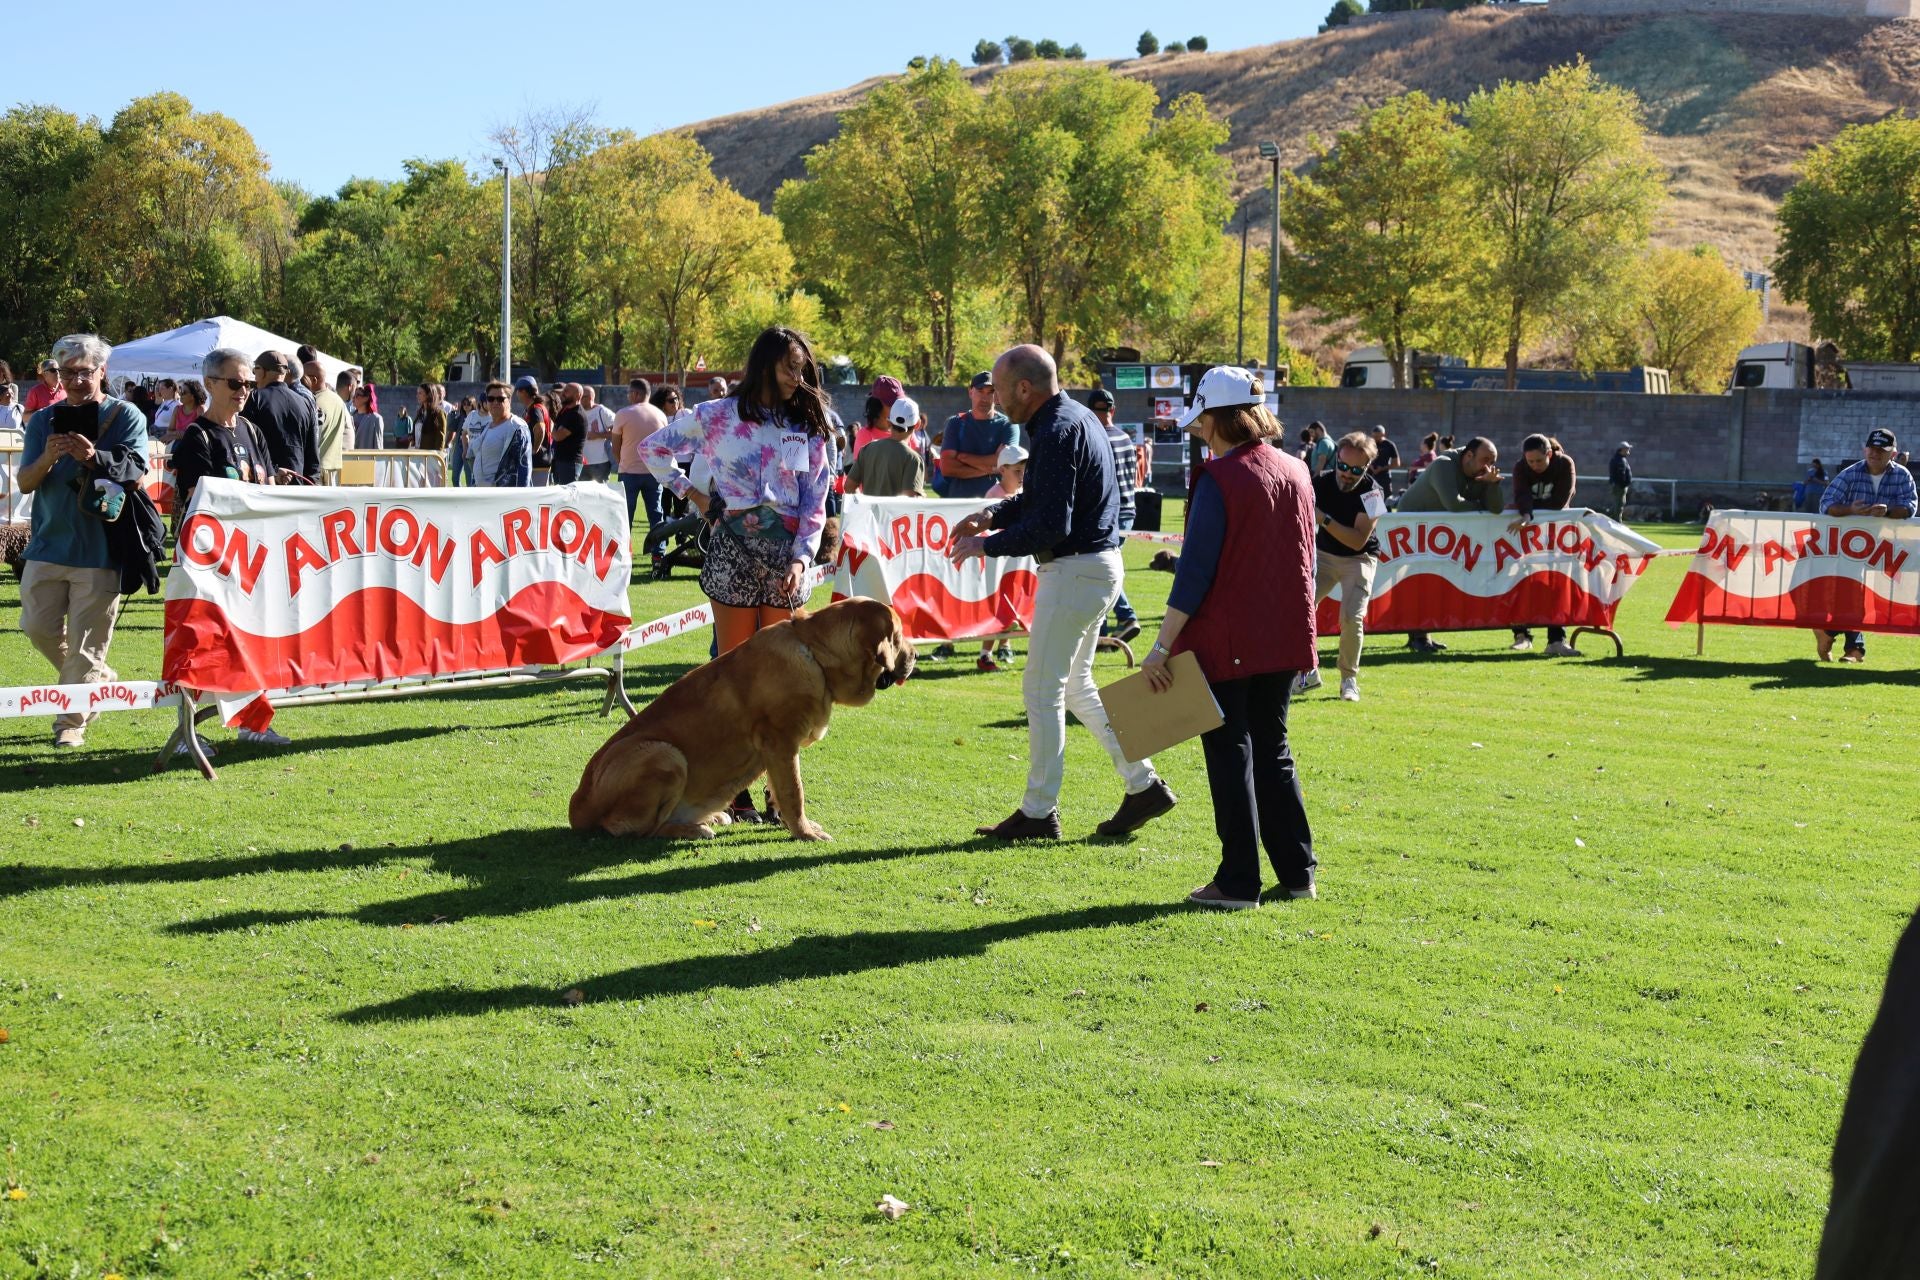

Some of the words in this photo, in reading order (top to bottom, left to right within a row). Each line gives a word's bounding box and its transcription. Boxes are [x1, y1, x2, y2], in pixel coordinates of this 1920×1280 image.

[782, 435, 806, 446] ARION
[285, 506, 457, 599] ARION
[470, 506, 619, 589] ARION
[1494, 522, 1607, 574] ARION
[1762, 526, 1908, 579] ARION
[641, 622, 670, 643] ARION
[679, 608, 707, 631] ARION
[20, 688, 71, 712] ARION
[89, 685, 138, 707] ARION
